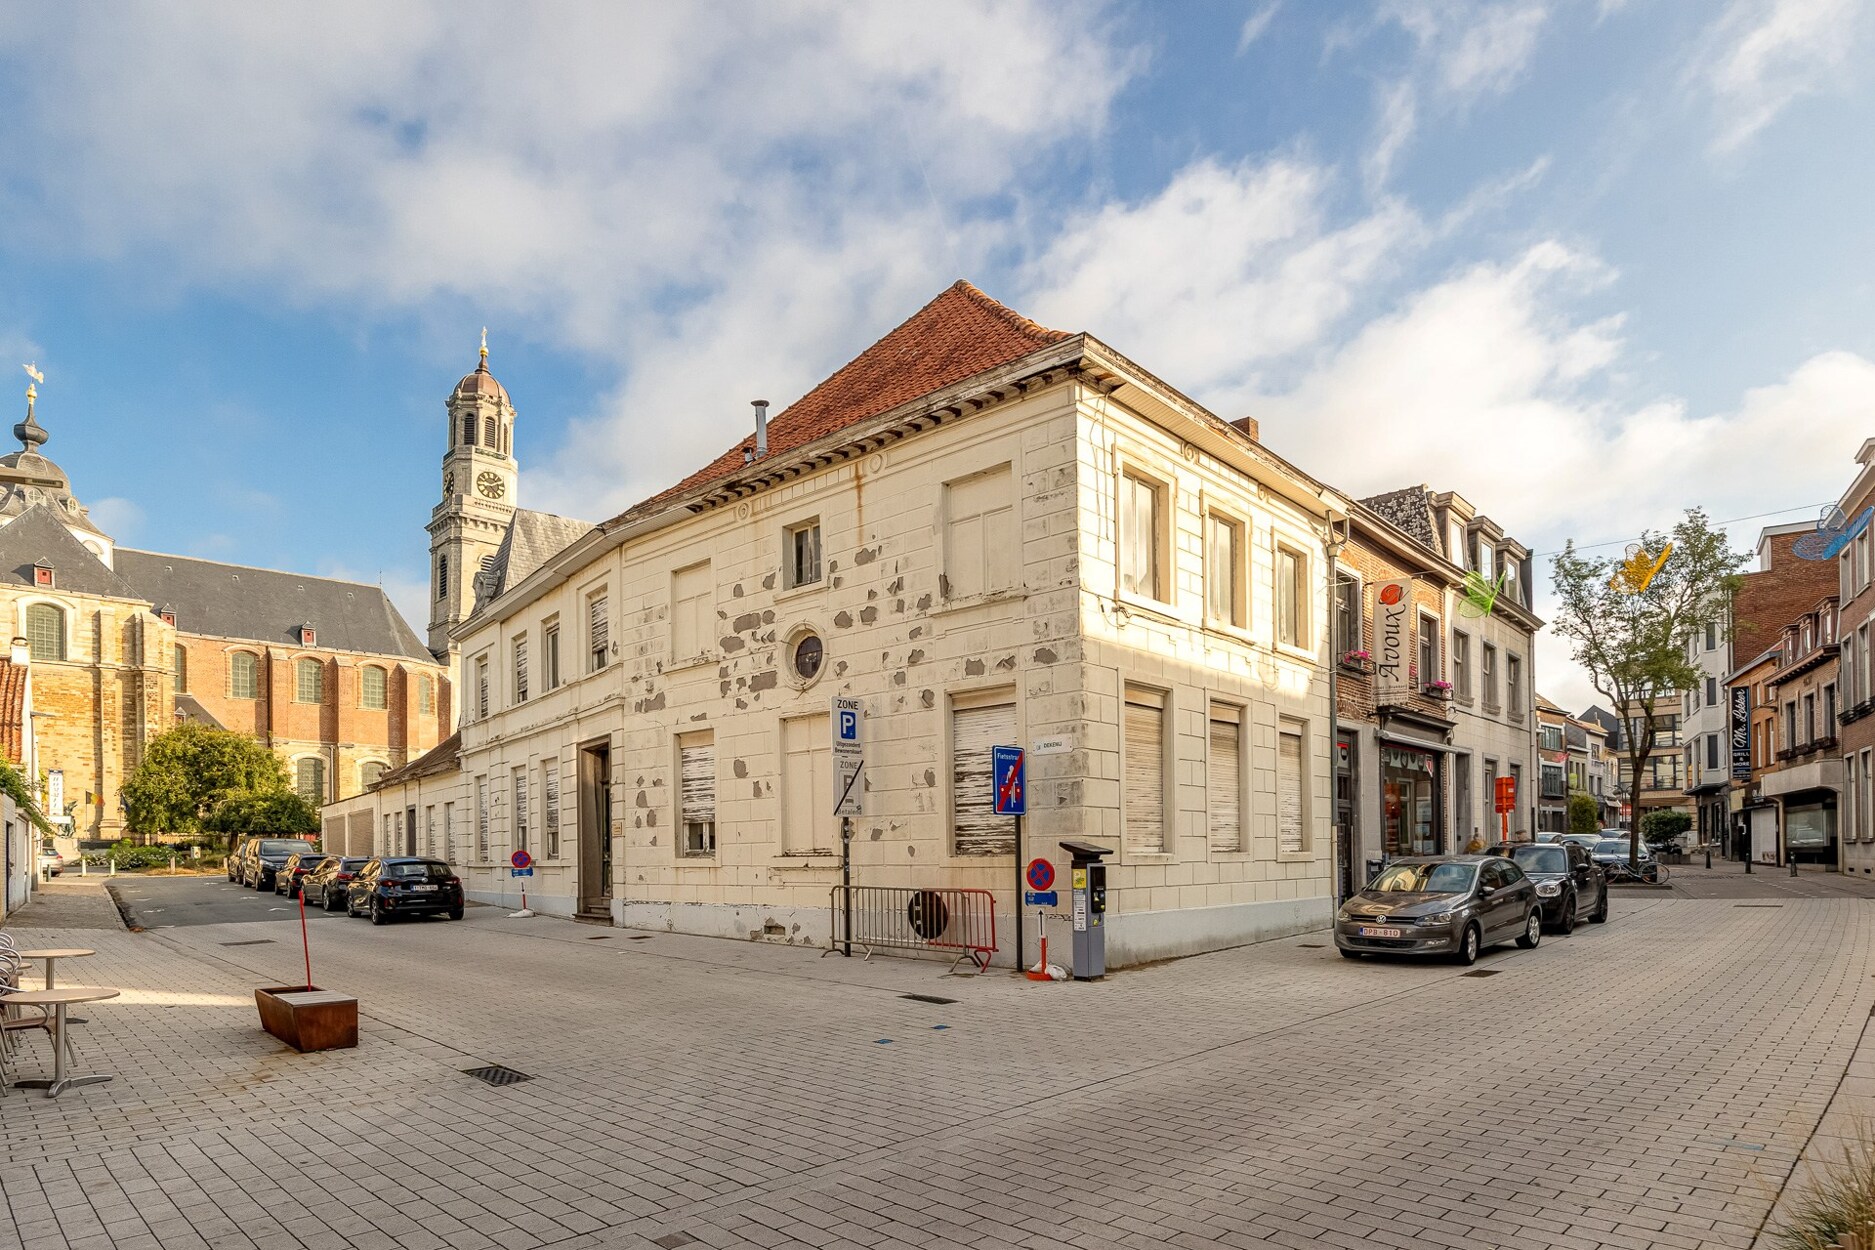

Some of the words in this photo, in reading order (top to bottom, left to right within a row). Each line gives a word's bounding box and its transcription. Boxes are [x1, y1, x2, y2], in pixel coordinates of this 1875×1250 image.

[1378, 604, 1406, 682] Avoux
[837, 699, 859, 710] ZONE
[1732, 688, 1747, 722] Lekker
[842, 714, 854, 734] P
[1733, 724, 1747, 748] Mr.
[840, 761, 858, 769] ZONE
